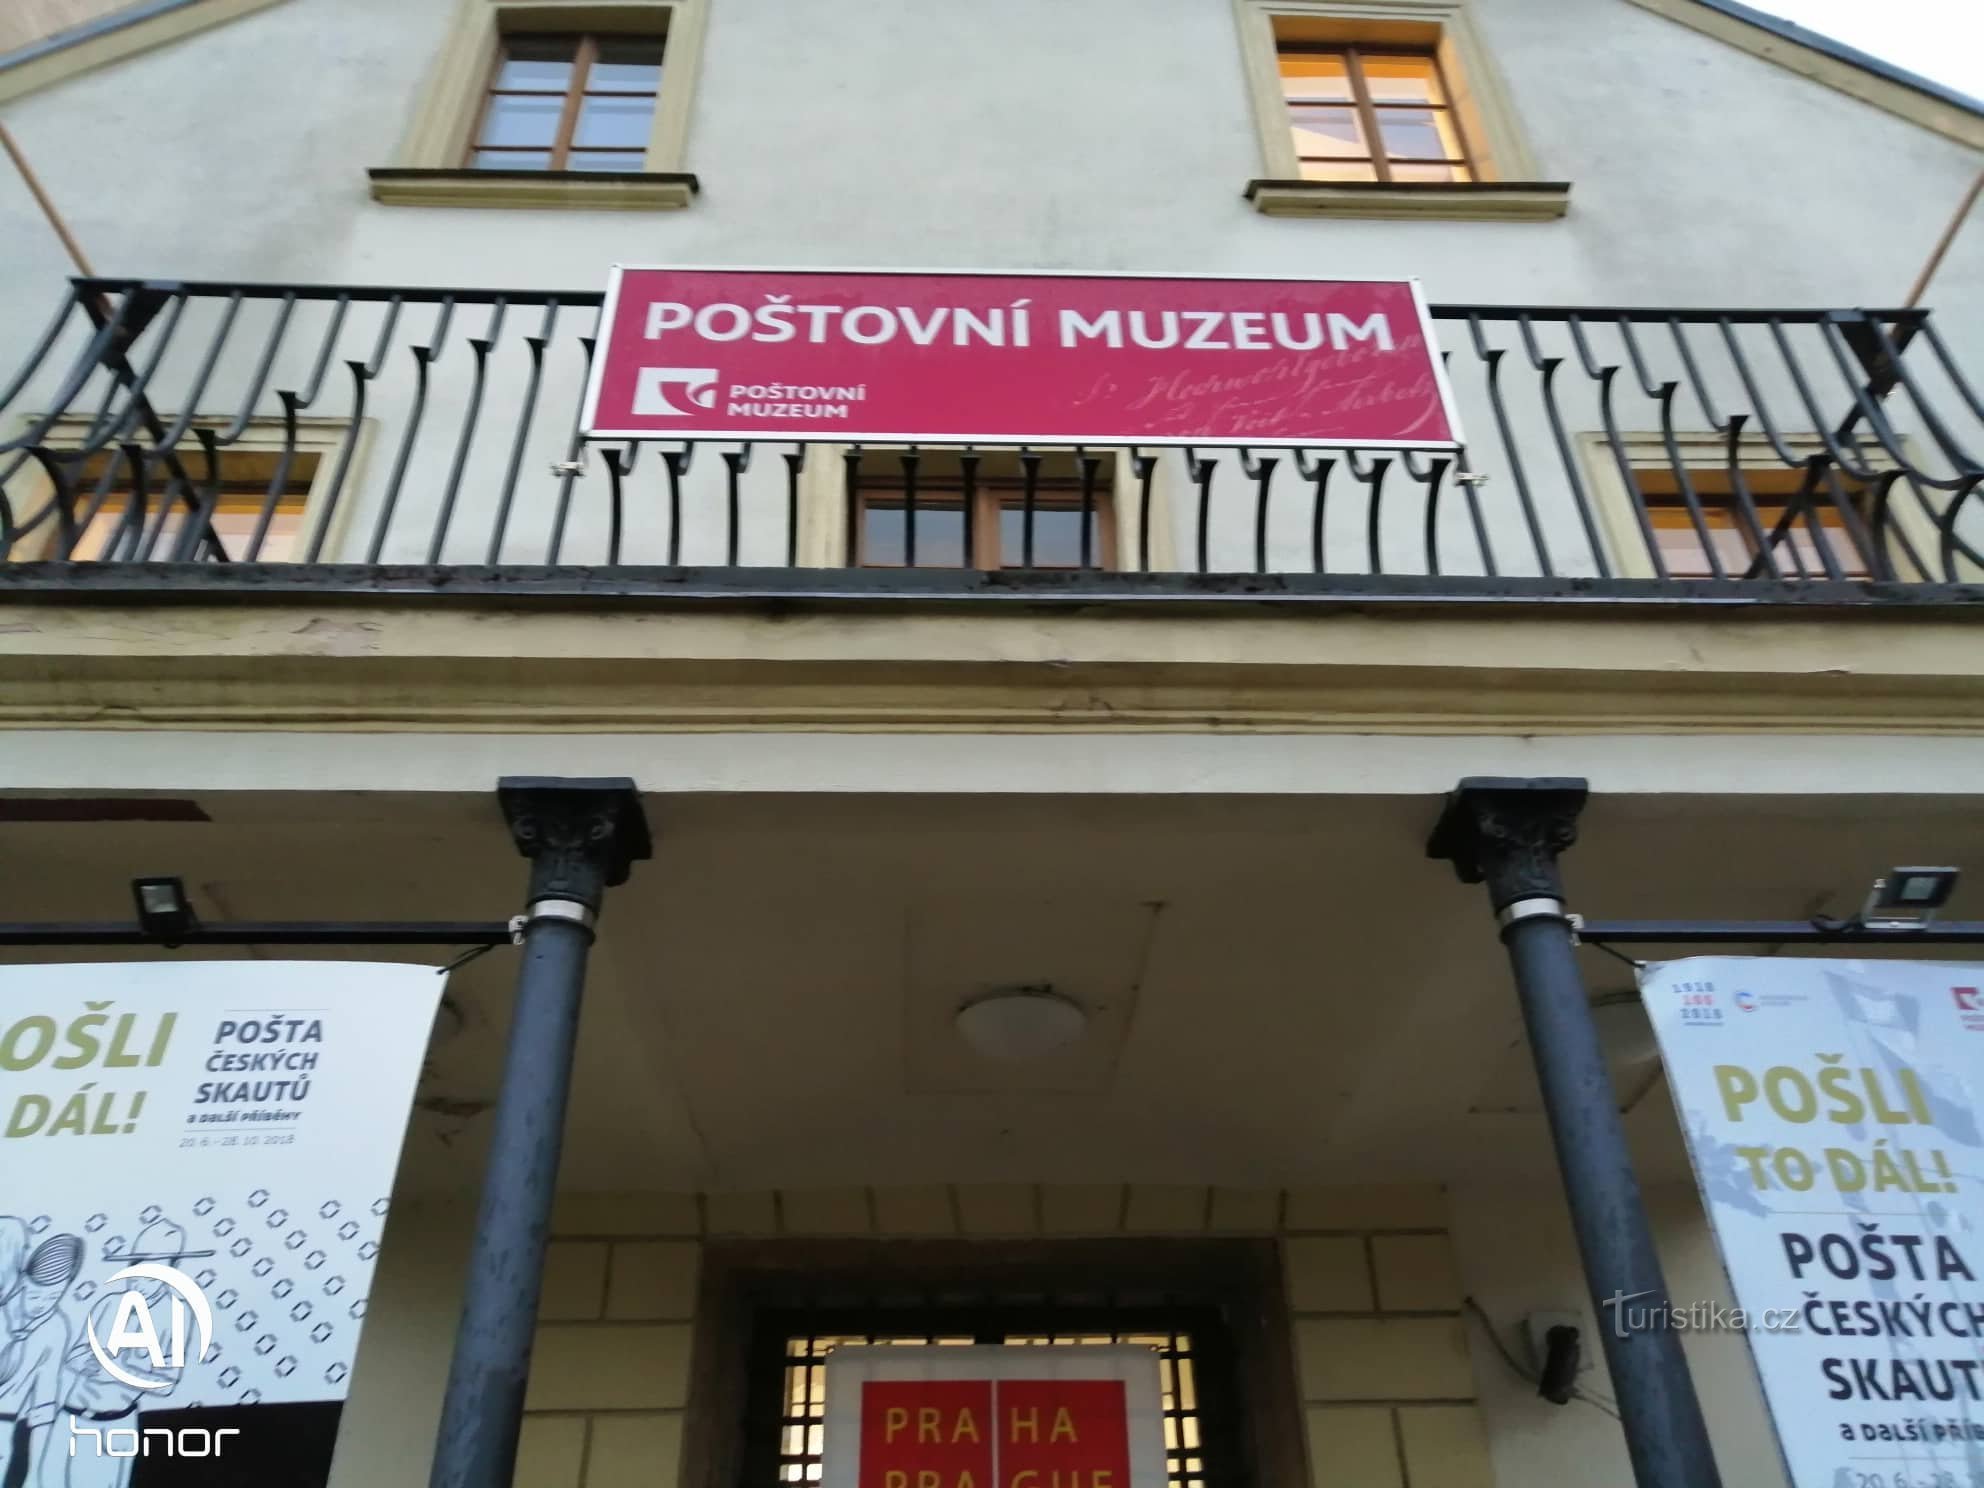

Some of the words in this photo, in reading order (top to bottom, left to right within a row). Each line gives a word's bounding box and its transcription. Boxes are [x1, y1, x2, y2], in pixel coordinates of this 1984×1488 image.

[643, 294, 1031, 347] POŠTOVNÍ
[1059, 309, 1394, 350] MUZEUM
[727, 402, 849, 419] MUZEUM
[729, 382, 867, 401] POŠTOVNÍ
[0, 1001, 178, 1071] OŠLI
[213, 1014, 324, 1045] POŠTA
[205, 1049, 319, 1074] ČESKÝCH
[4, 1082, 148, 1138] DÁL!
[193, 1073, 311, 1105] SKAUTŮ
[1713, 1053, 1934, 1125] POŠLI
[1735, 1146, 1815, 1191] TO
[1823, 1138, 1959, 1194] DÁL!
[1781, 1223, 1976, 1281] POŠTA
[1821, 1359, 1984, 1401] SKAUT
[1839, 1423, 1856, 1441] a
